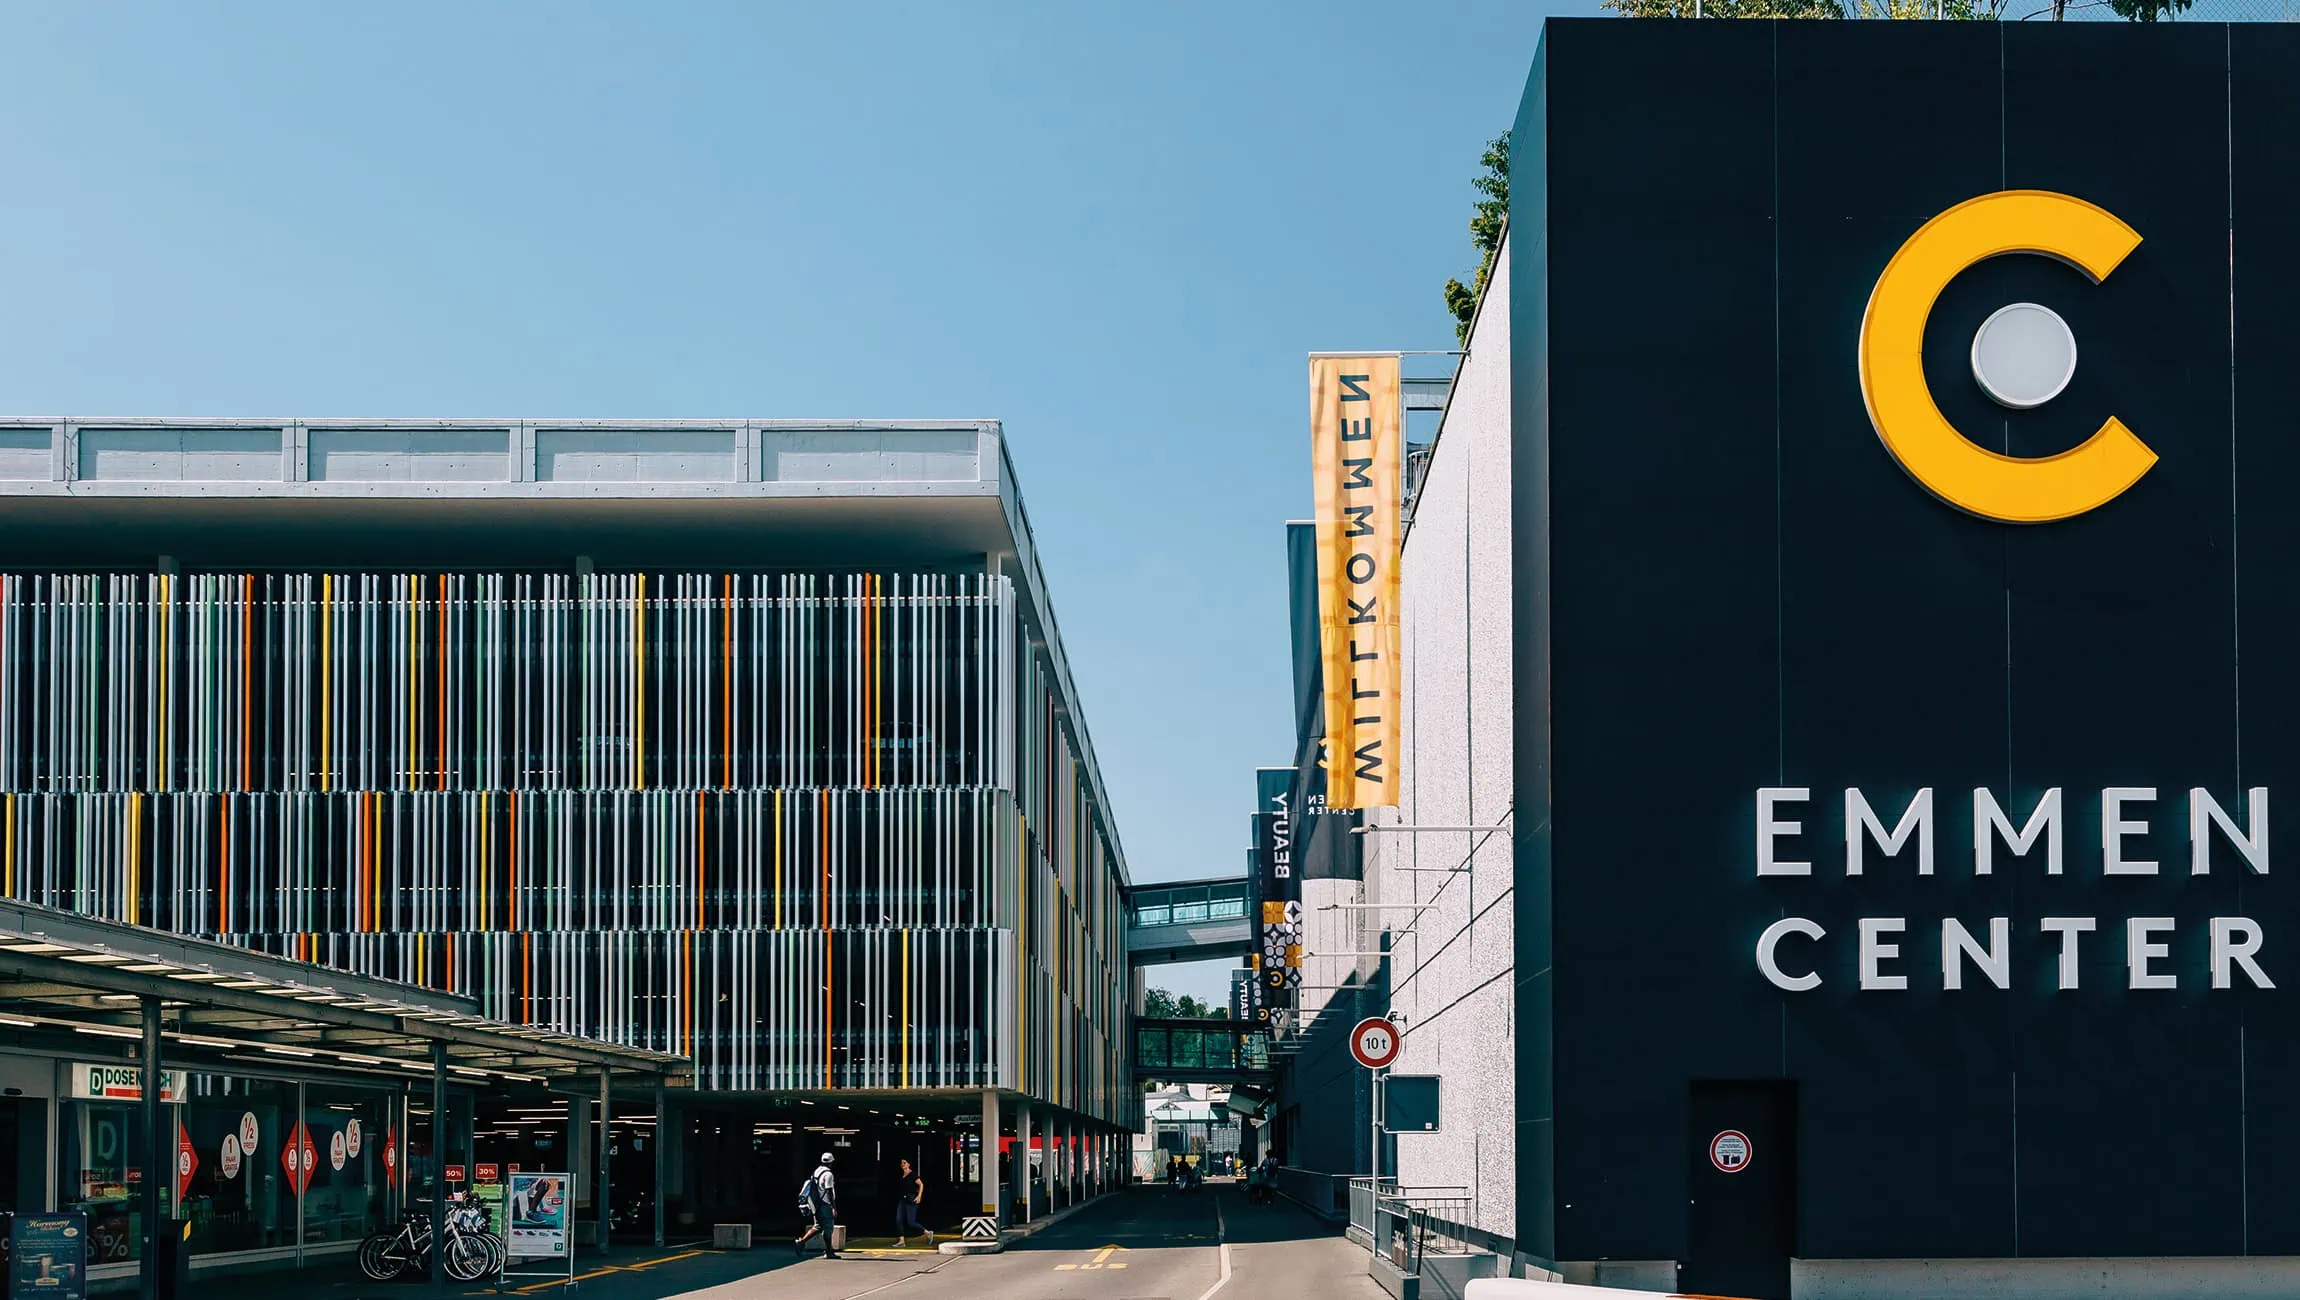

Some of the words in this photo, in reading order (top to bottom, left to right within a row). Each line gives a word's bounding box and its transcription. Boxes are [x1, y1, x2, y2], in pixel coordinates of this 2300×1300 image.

[1756, 787, 2269, 876] EMMEN
[1756, 917, 2277, 992] CENTER
[1366, 1037, 1379, 1050] 10
[1381, 1038, 1387, 1050] t
[105, 1069, 172, 1088] DOSENCH
[227, 1138, 233, 1153] 1
[446, 1169, 462, 1177] 50%
[1053, 1263, 1128, 1271] BUS
